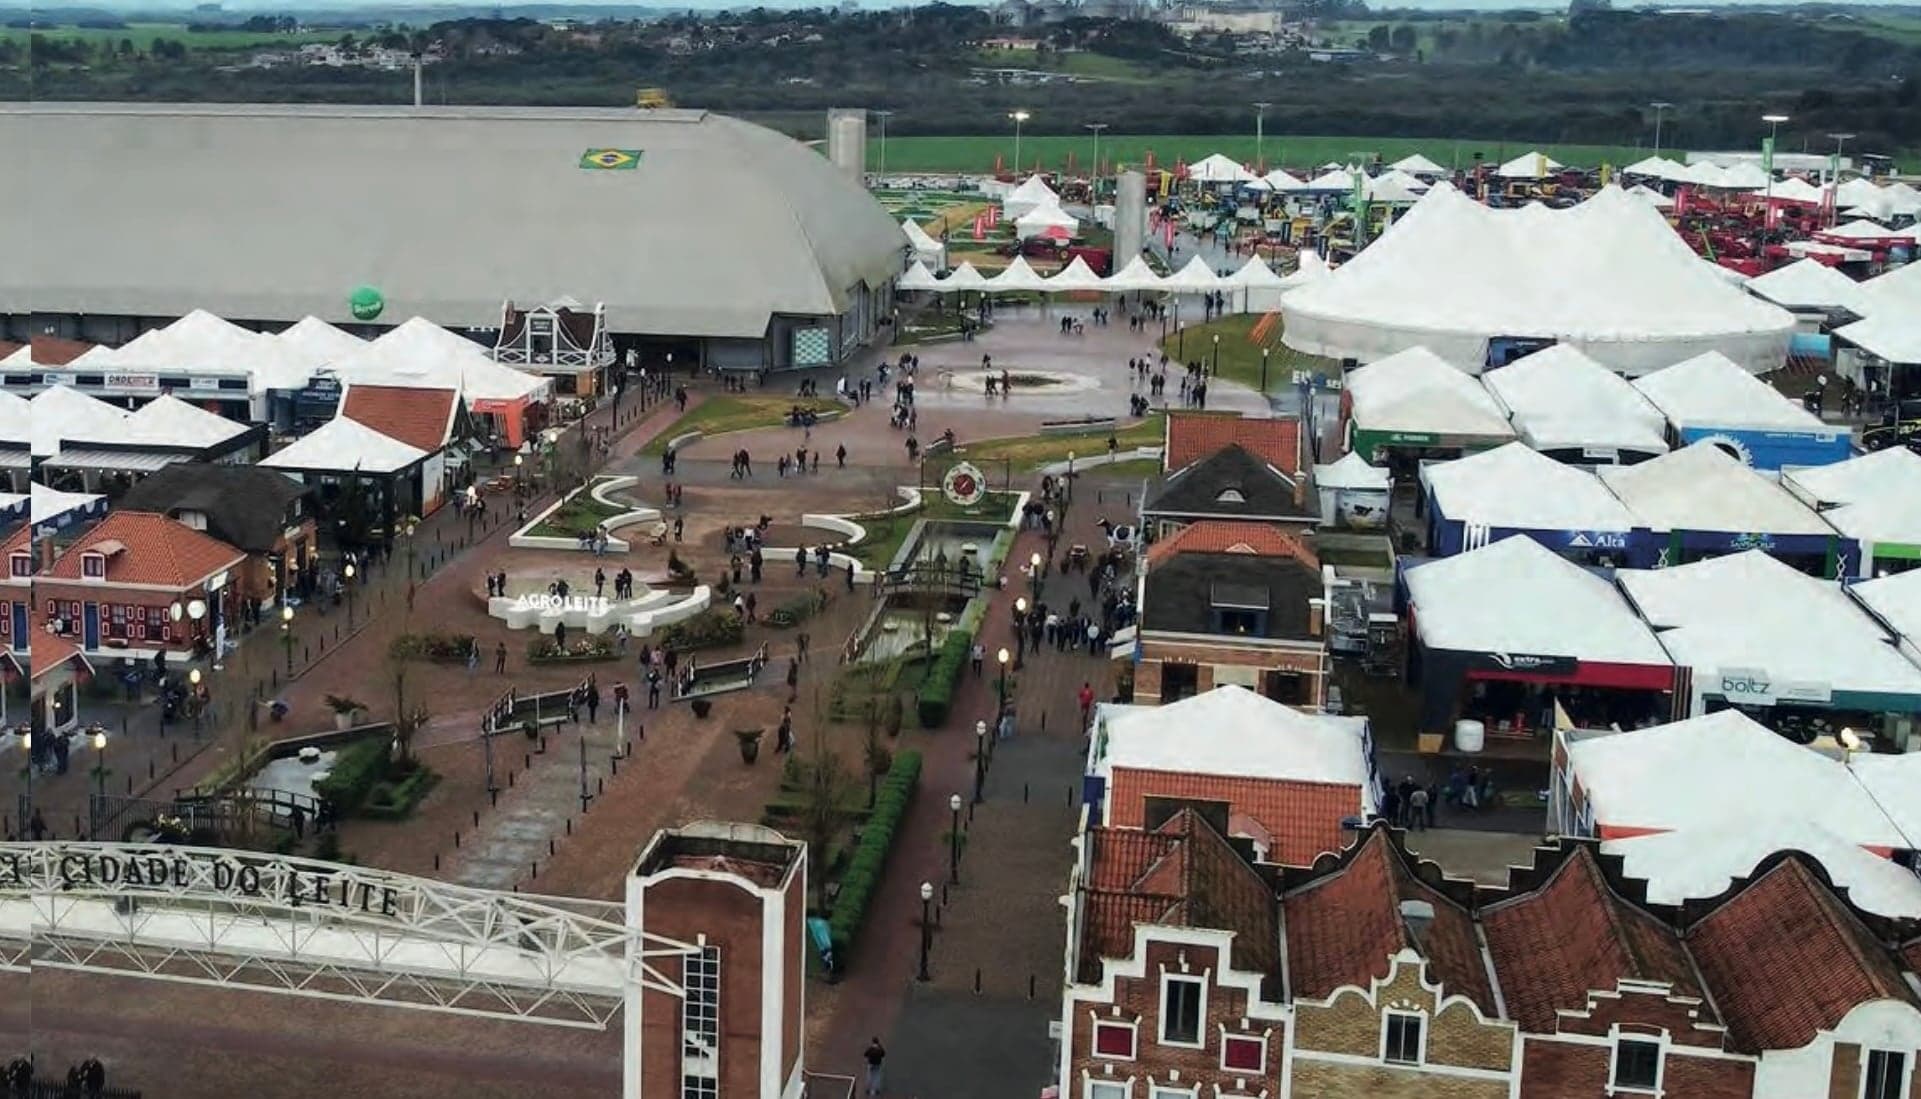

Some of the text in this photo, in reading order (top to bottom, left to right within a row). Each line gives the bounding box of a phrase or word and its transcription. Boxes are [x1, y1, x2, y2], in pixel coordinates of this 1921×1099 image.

[1594, 534, 1626, 548] Alta
[1721, 676, 1771, 695] boltz
[60, 855, 398, 917] CIDADE DO LEITE
